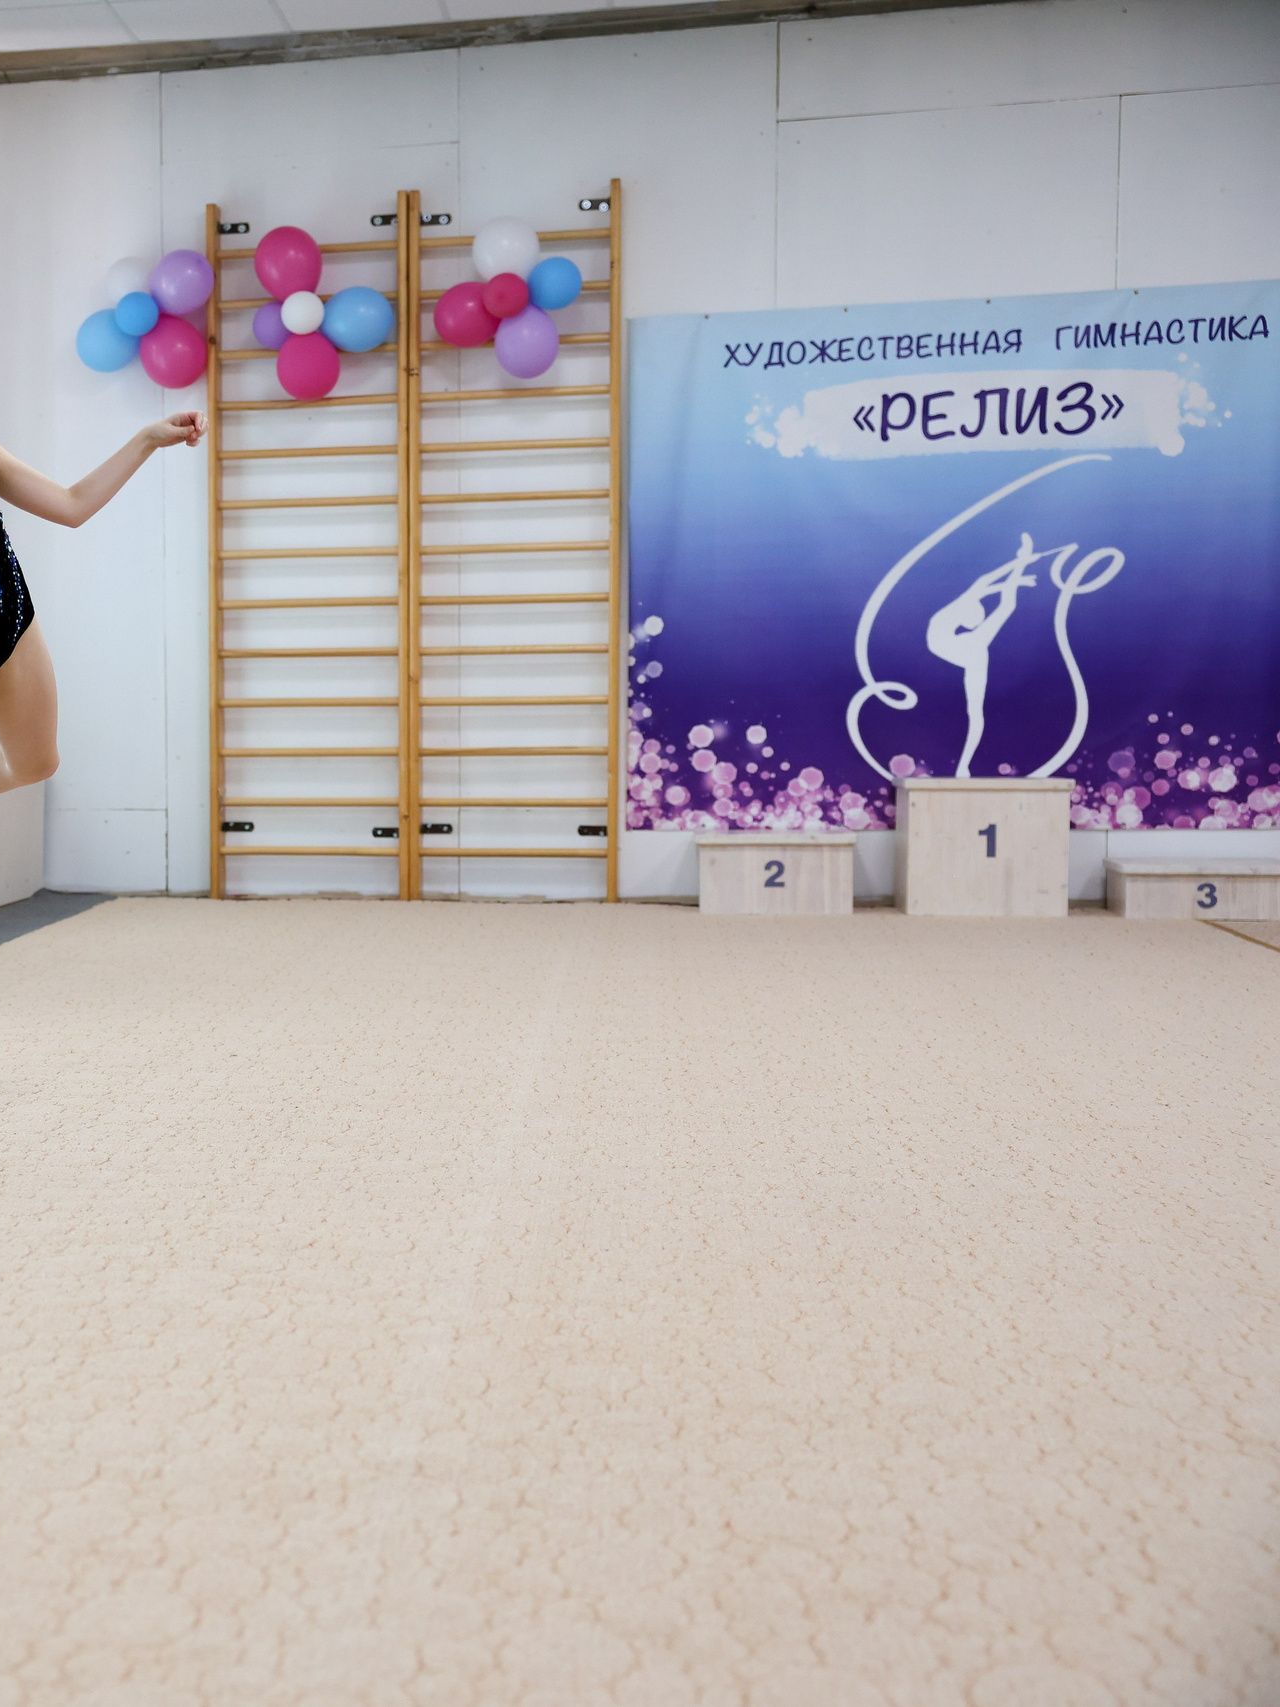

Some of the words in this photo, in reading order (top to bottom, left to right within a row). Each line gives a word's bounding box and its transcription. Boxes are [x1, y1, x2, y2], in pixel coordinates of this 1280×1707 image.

[723, 328, 1023, 370] ХУДОЖЕСТВЕННАЯ
[1054, 314, 1270, 351] ГИМНАСТИКА
[852, 381, 1125, 441] «РЕЛИЗ»
[978, 823, 998, 858] 1
[763, 860, 786, 889] 2
[1196, 882, 1219, 909] 3
